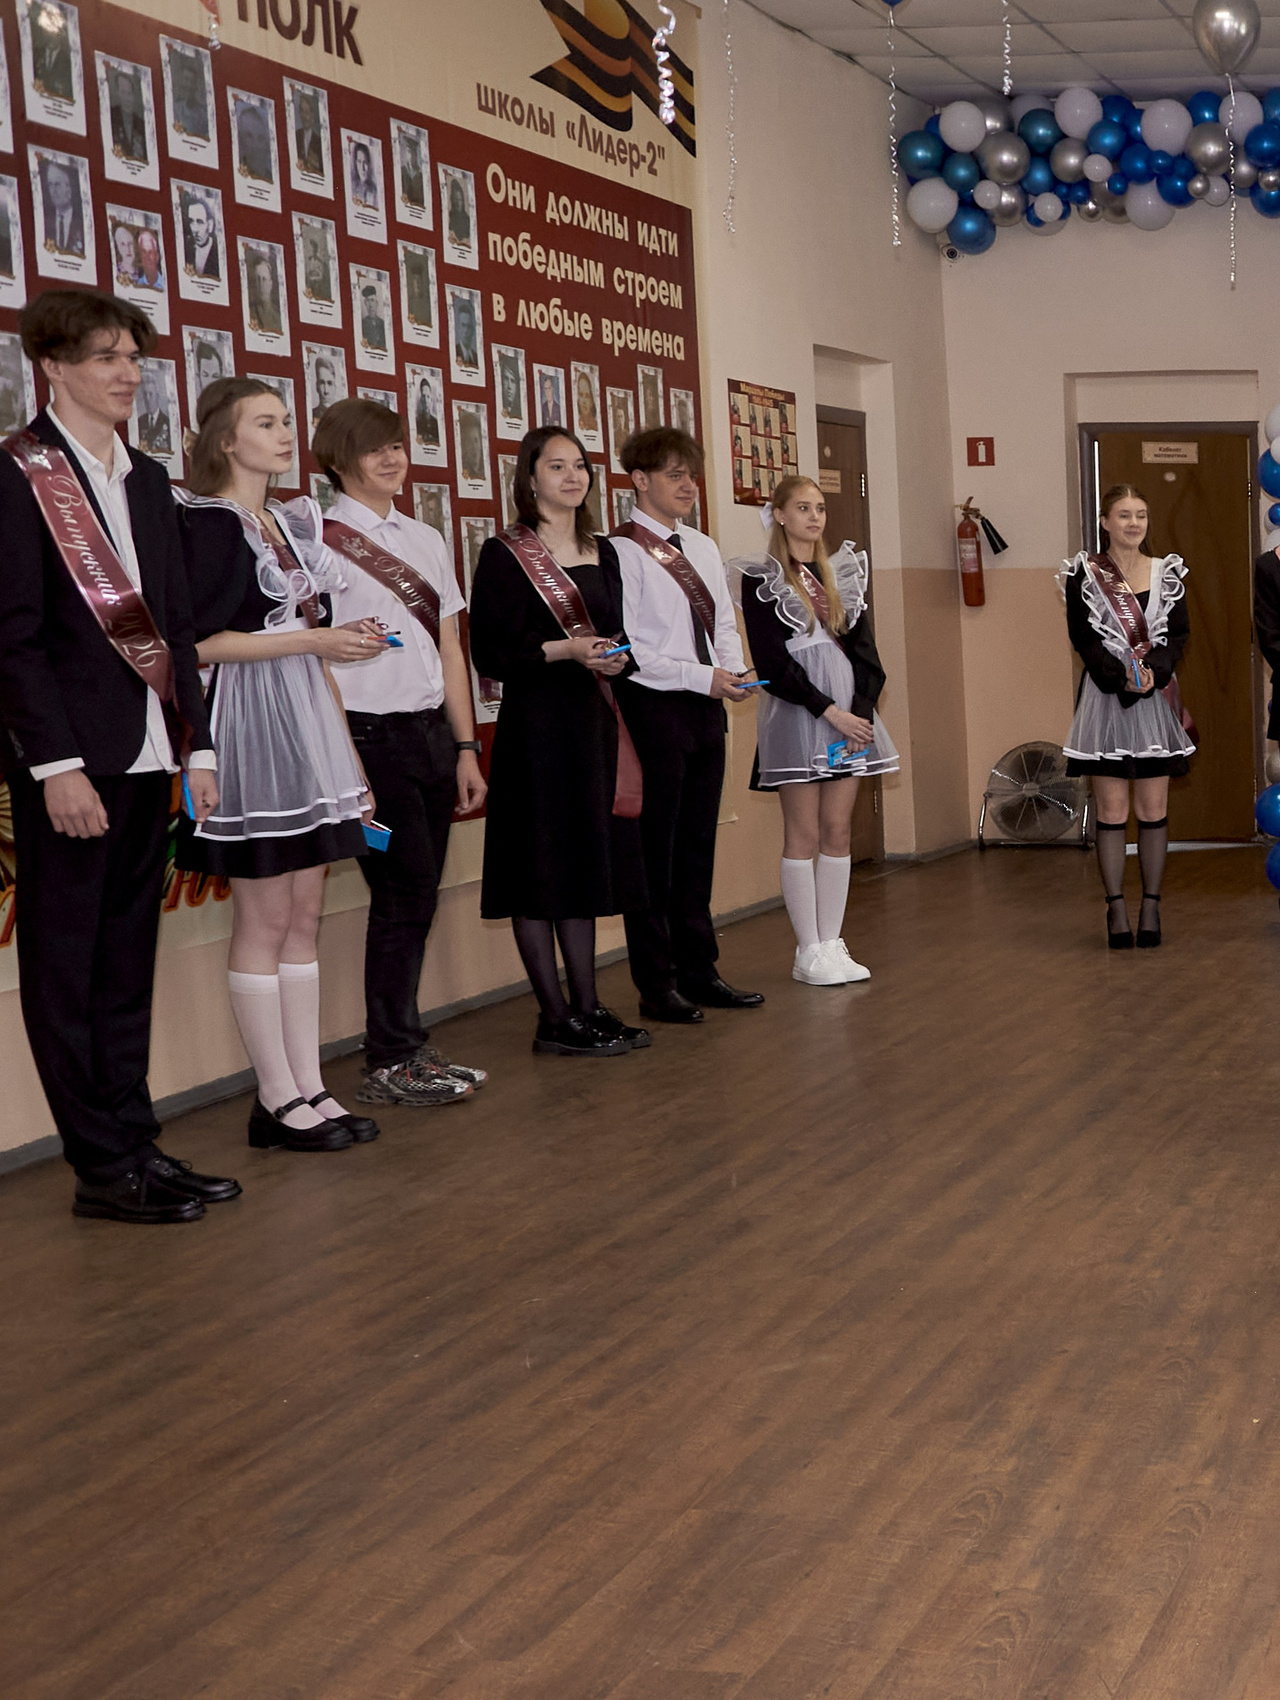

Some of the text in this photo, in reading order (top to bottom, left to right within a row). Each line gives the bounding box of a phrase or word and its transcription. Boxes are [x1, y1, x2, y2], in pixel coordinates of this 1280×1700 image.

[476, 82, 556, 138] школы
[486, 162, 679, 258] Они должны идти
[487, 231, 683, 310] победным строем
[492, 292, 686, 361] в любые времена
[47, 474, 168, 668] Выпускник 2026
